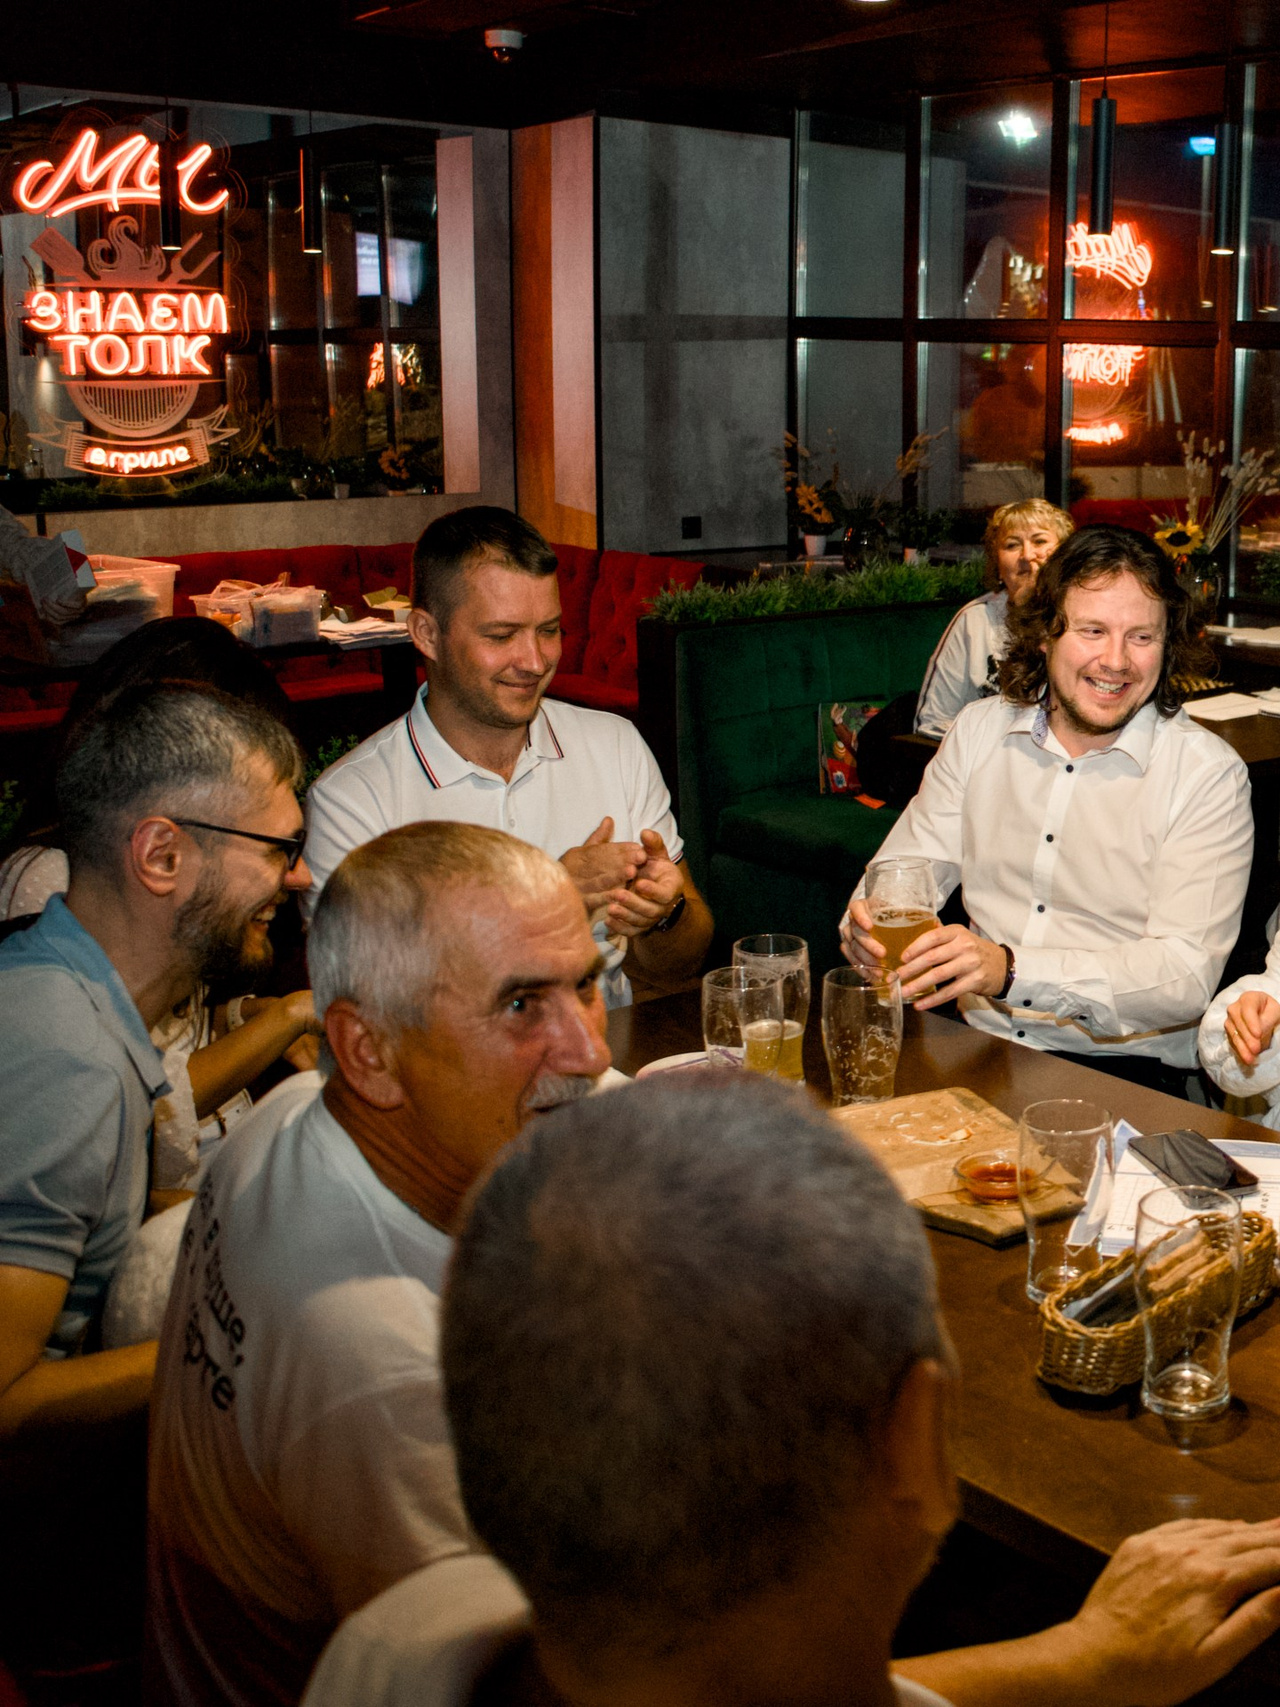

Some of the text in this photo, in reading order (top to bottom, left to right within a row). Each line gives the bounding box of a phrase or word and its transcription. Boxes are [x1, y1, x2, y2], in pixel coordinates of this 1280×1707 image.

[14, 128, 229, 217] Мы
[27, 290, 229, 333] ЗНАЕМ
[50, 334, 212, 375] ТОЛК
